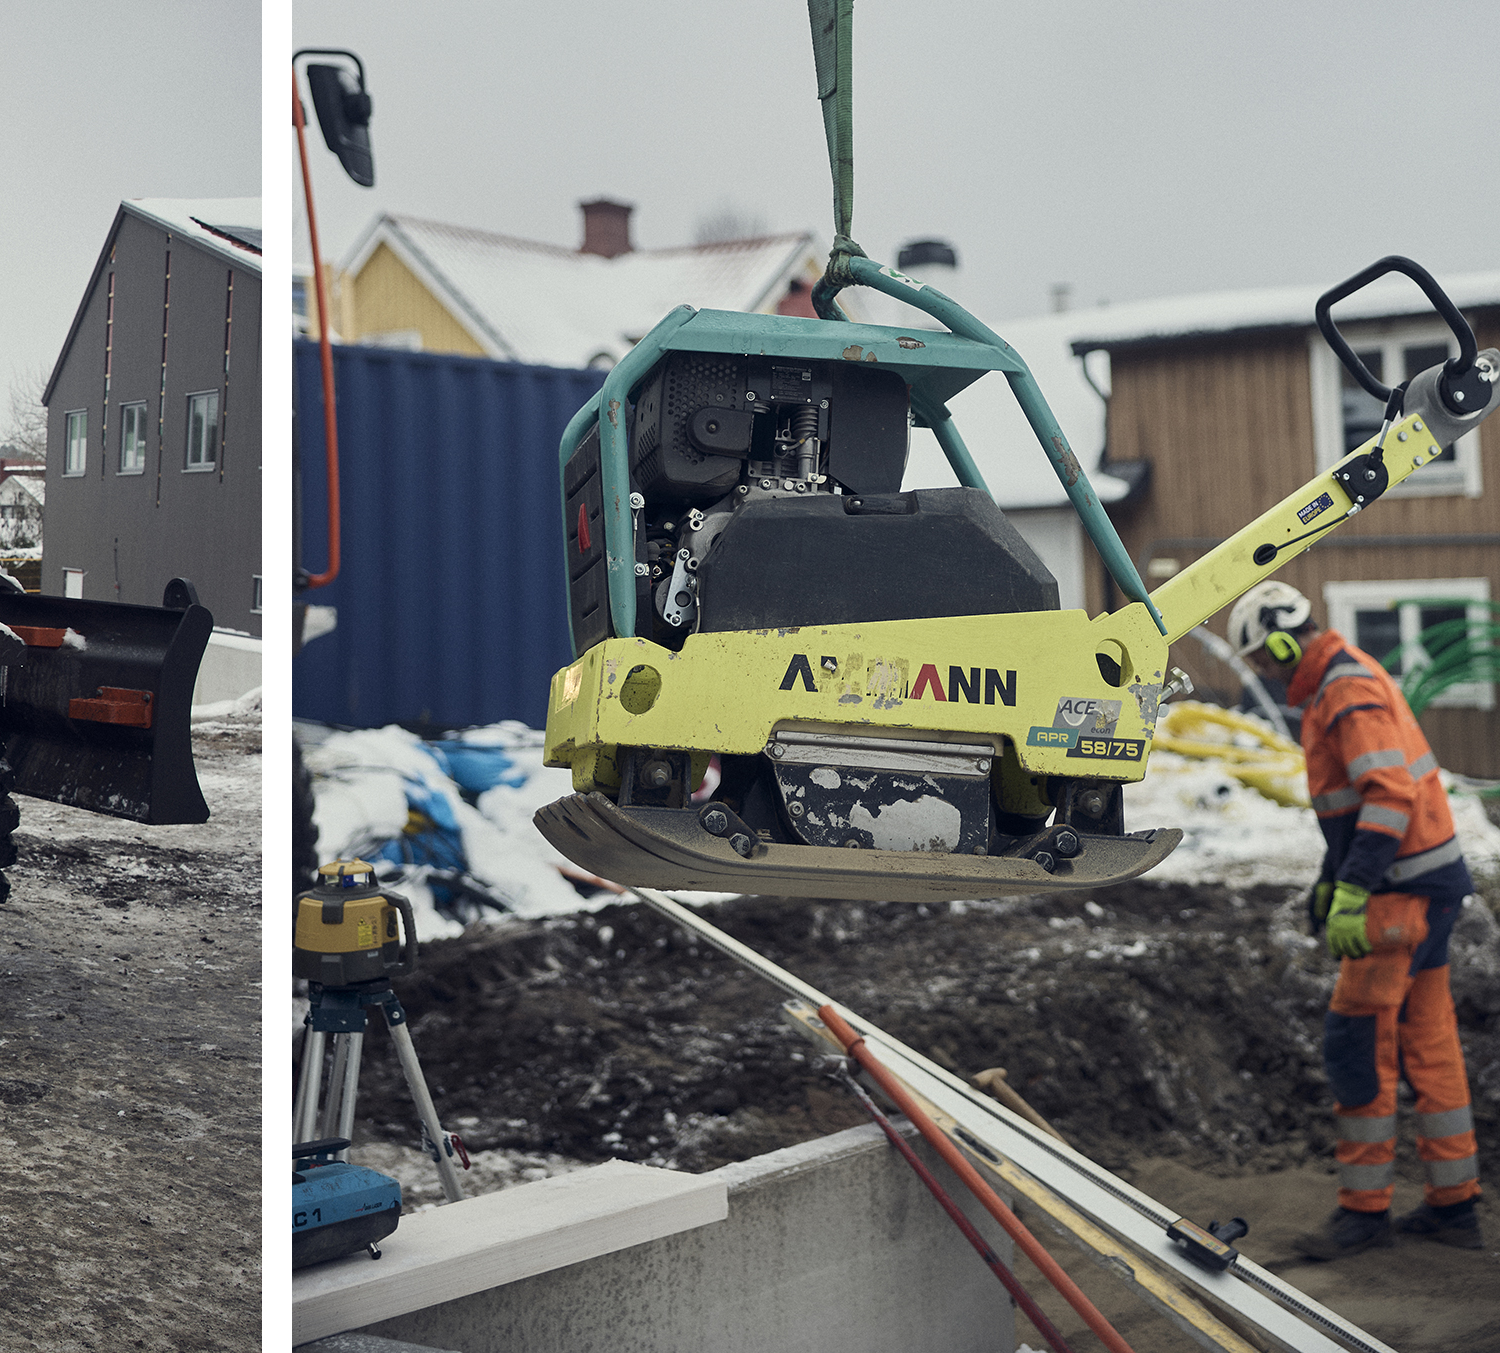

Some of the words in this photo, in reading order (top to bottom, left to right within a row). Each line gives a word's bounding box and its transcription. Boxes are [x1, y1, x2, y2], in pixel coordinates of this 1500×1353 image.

[1298, 504, 1313, 518] MADE
[1302, 506, 1322, 523] EUROPE
[778, 653, 1017, 707] AANN
[1059, 700, 1096, 715] ACE
[1036, 732, 1069, 743] APR
[1081, 740, 1138, 757] 58/75
[292, 1211, 308, 1228] C
